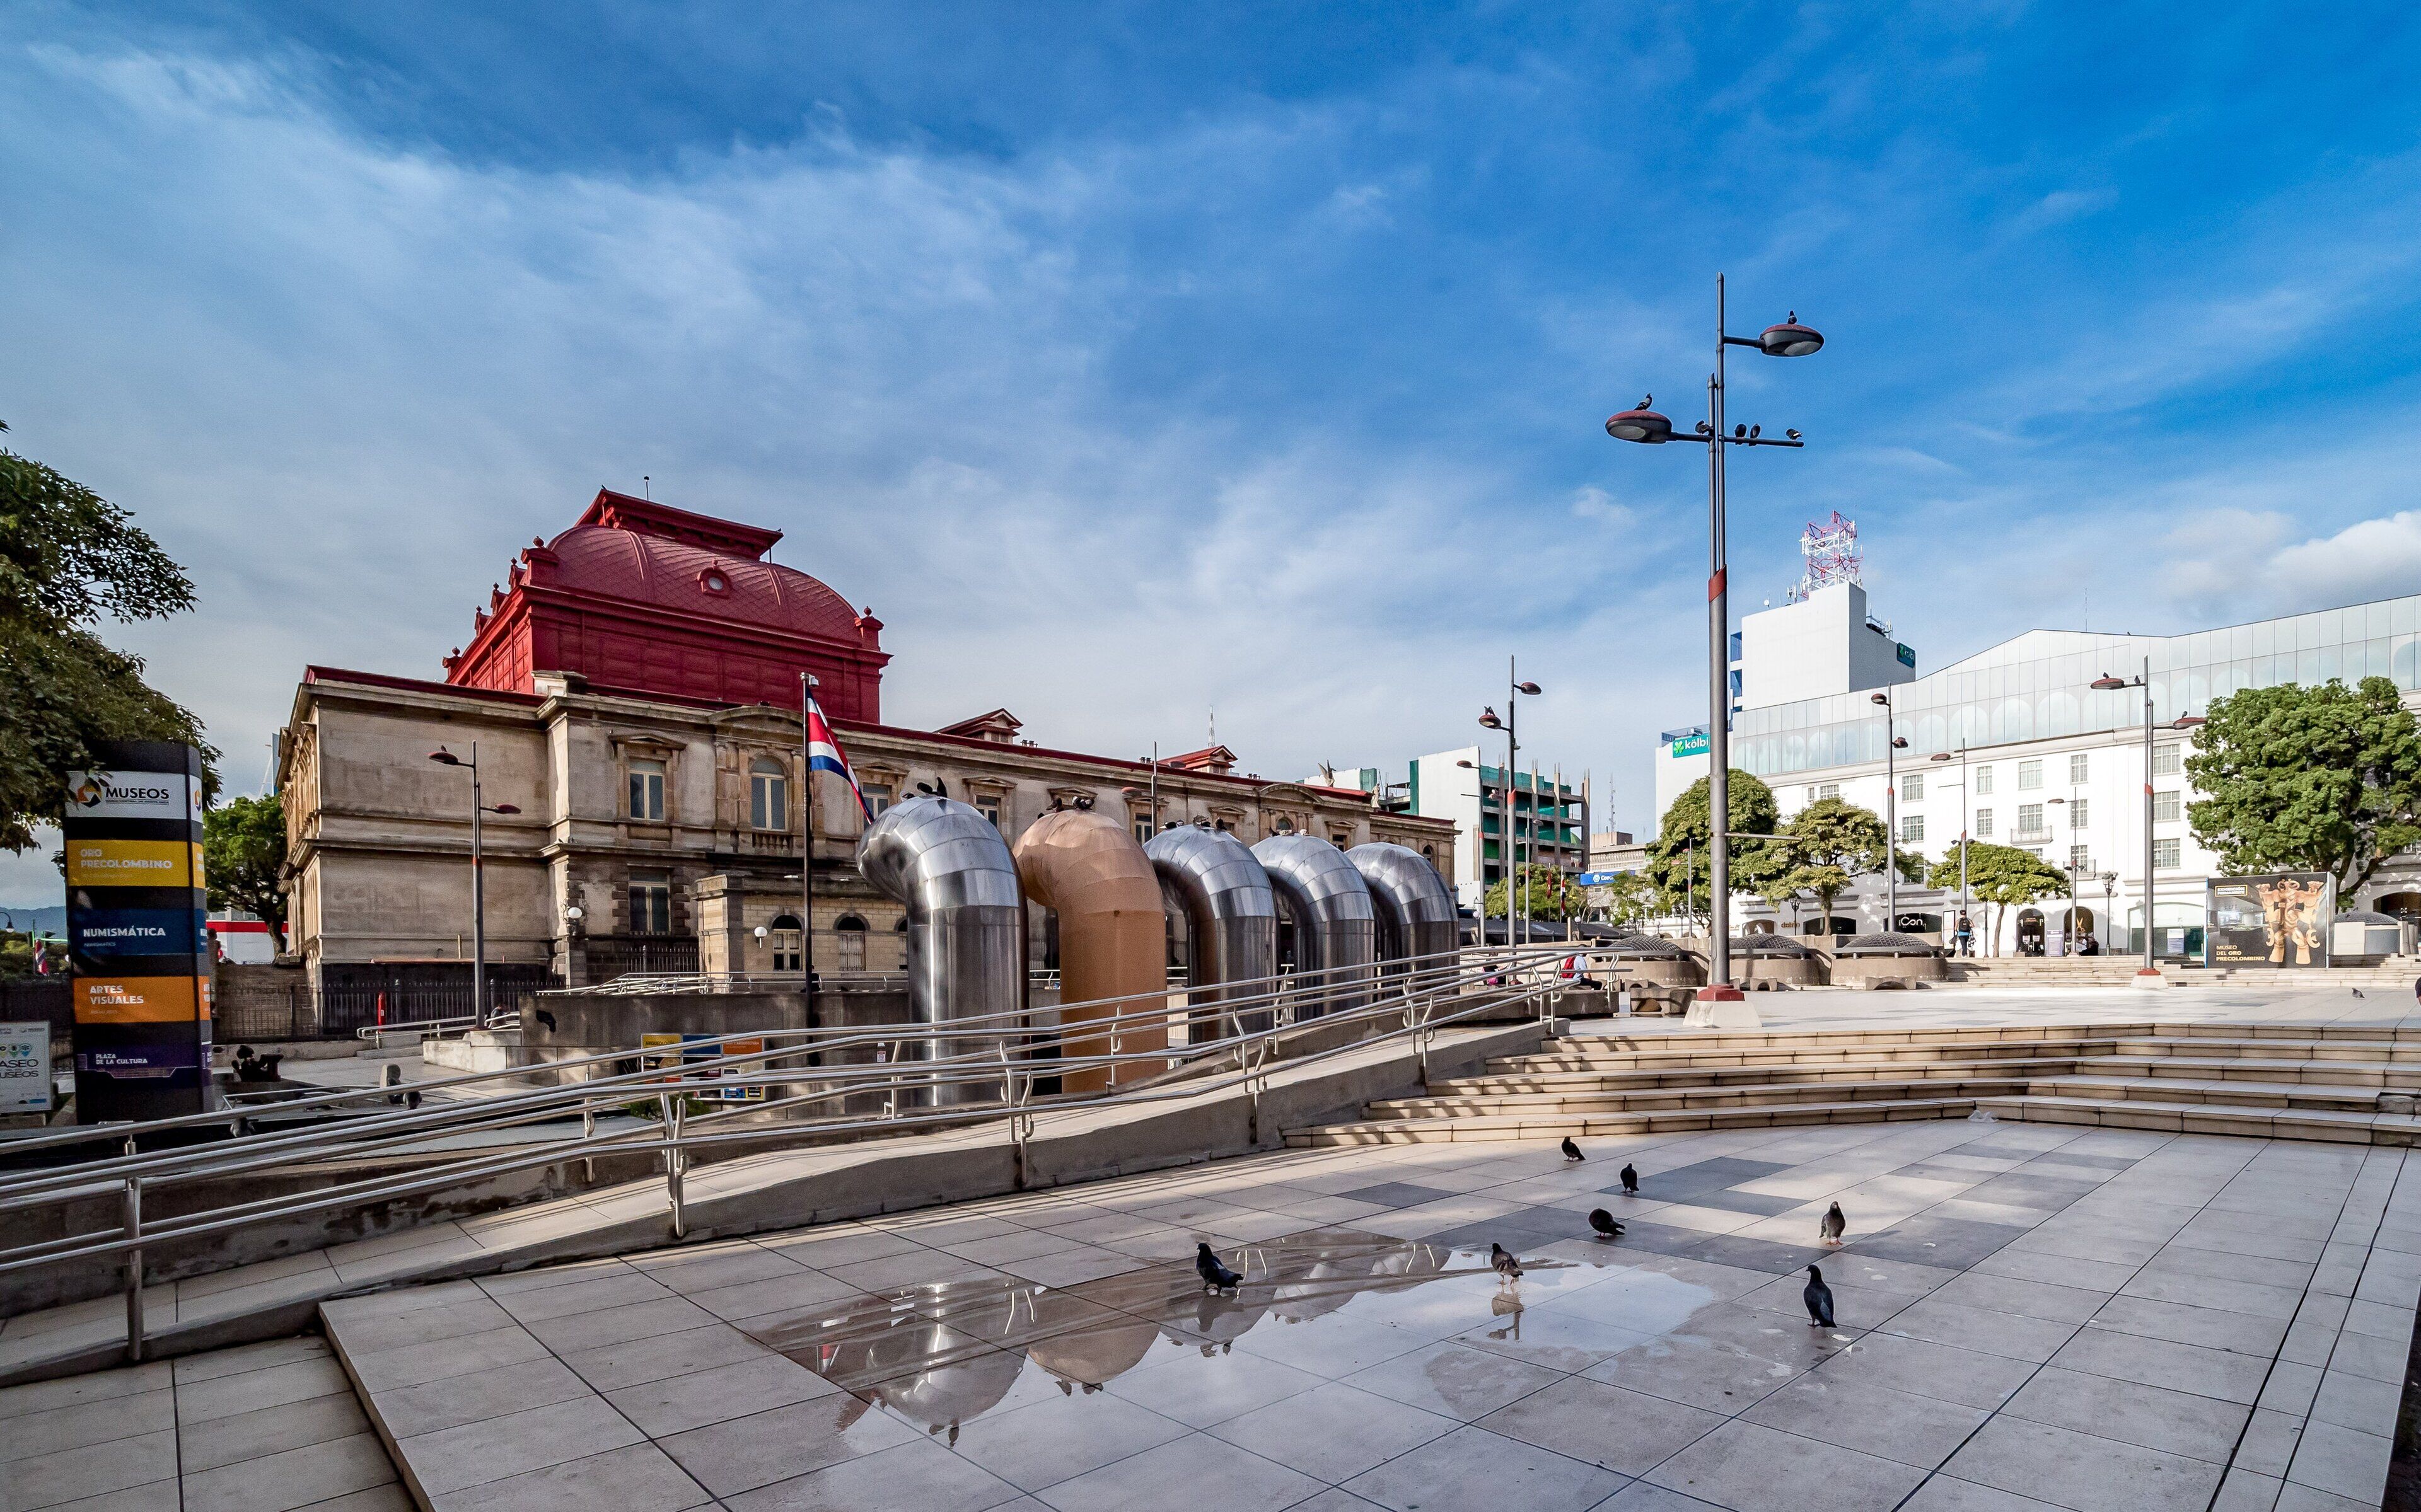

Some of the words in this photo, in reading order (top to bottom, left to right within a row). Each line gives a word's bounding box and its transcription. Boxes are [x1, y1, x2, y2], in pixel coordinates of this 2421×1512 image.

[106, 787, 169, 799] MUSEOS
[81, 848, 102, 857] ORO
[81, 860, 173, 869] PRECOLOMBINO
[83, 925, 166, 937] NUMISMÁTICA
[90, 985, 124, 994] ARTES
[90, 995, 144, 1005] VISUALES
